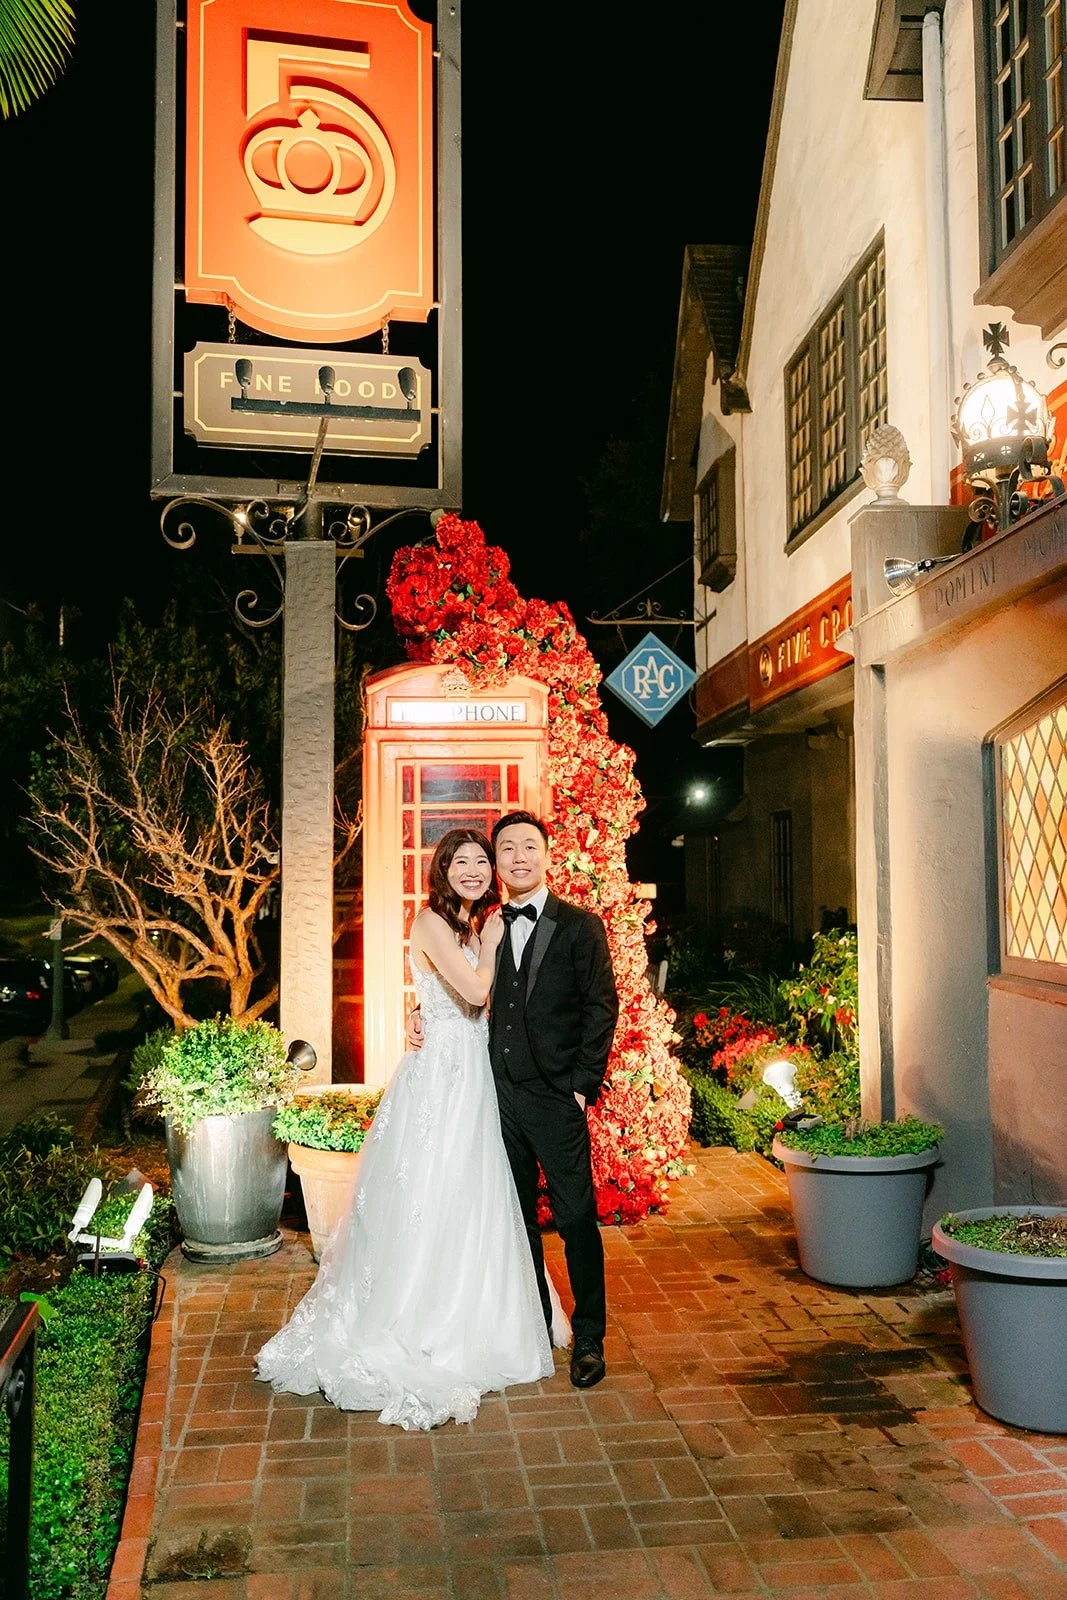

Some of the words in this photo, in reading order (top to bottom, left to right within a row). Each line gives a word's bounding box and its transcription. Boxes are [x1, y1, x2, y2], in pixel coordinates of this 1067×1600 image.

[245, 37, 397, 256] 5
[220, 371, 292, 393] FNE
[777, 625, 811, 673] FIVE
[632, 655, 676, 699] RAC
[397, 704, 521, 722] PHONE
